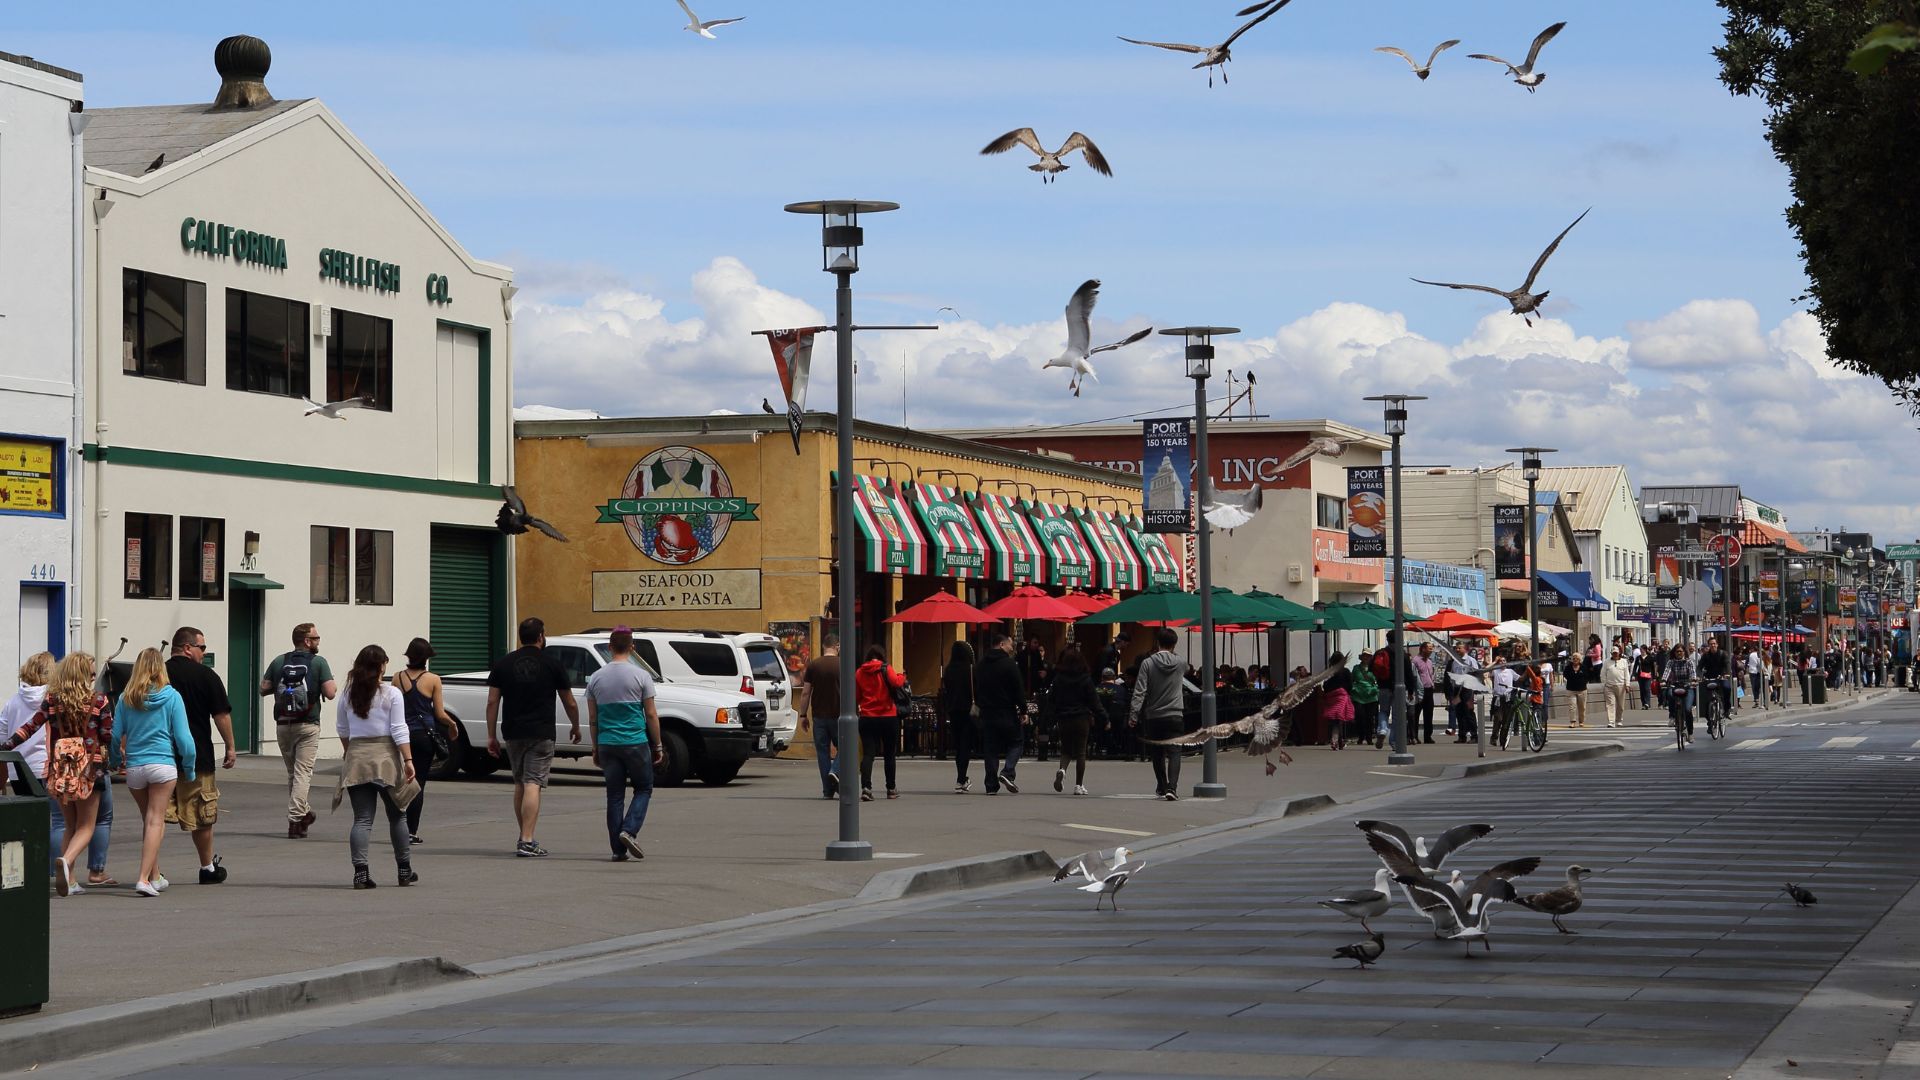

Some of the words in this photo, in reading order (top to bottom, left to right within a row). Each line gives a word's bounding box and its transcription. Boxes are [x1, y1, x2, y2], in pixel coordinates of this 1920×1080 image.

[181, 216, 288, 269] CALIFORNIA
[319, 247, 401, 293] SHELLFISH
[426, 272, 453, 304] CO.
[1152, 422, 1182, 435] PORT
[1146, 439, 1160, 447] 150
[1162, 438, 1188, 446] YEARS
[1222, 457, 1285, 482] INC.
[1354, 470, 1379, 479] PORT
[614, 499, 740, 513] CIOPPINO'S
[1500, 508, 1520, 516] PORT
[1147, 514, 1187, 524] HISTORY
[1354, 543, 1382, 552] DINING
[240, 556, 257, 571] 420
[891, 551, 905, 563] PIZZA
[31, 563, 56, 580] 440
[1014, 563, 1030, 574] SEAFOOD
[638, 574, 714, 588] SEAFOOD
[620, 594, 667, 607] PIZZA
[682, 592, 732, 606] PASTA
